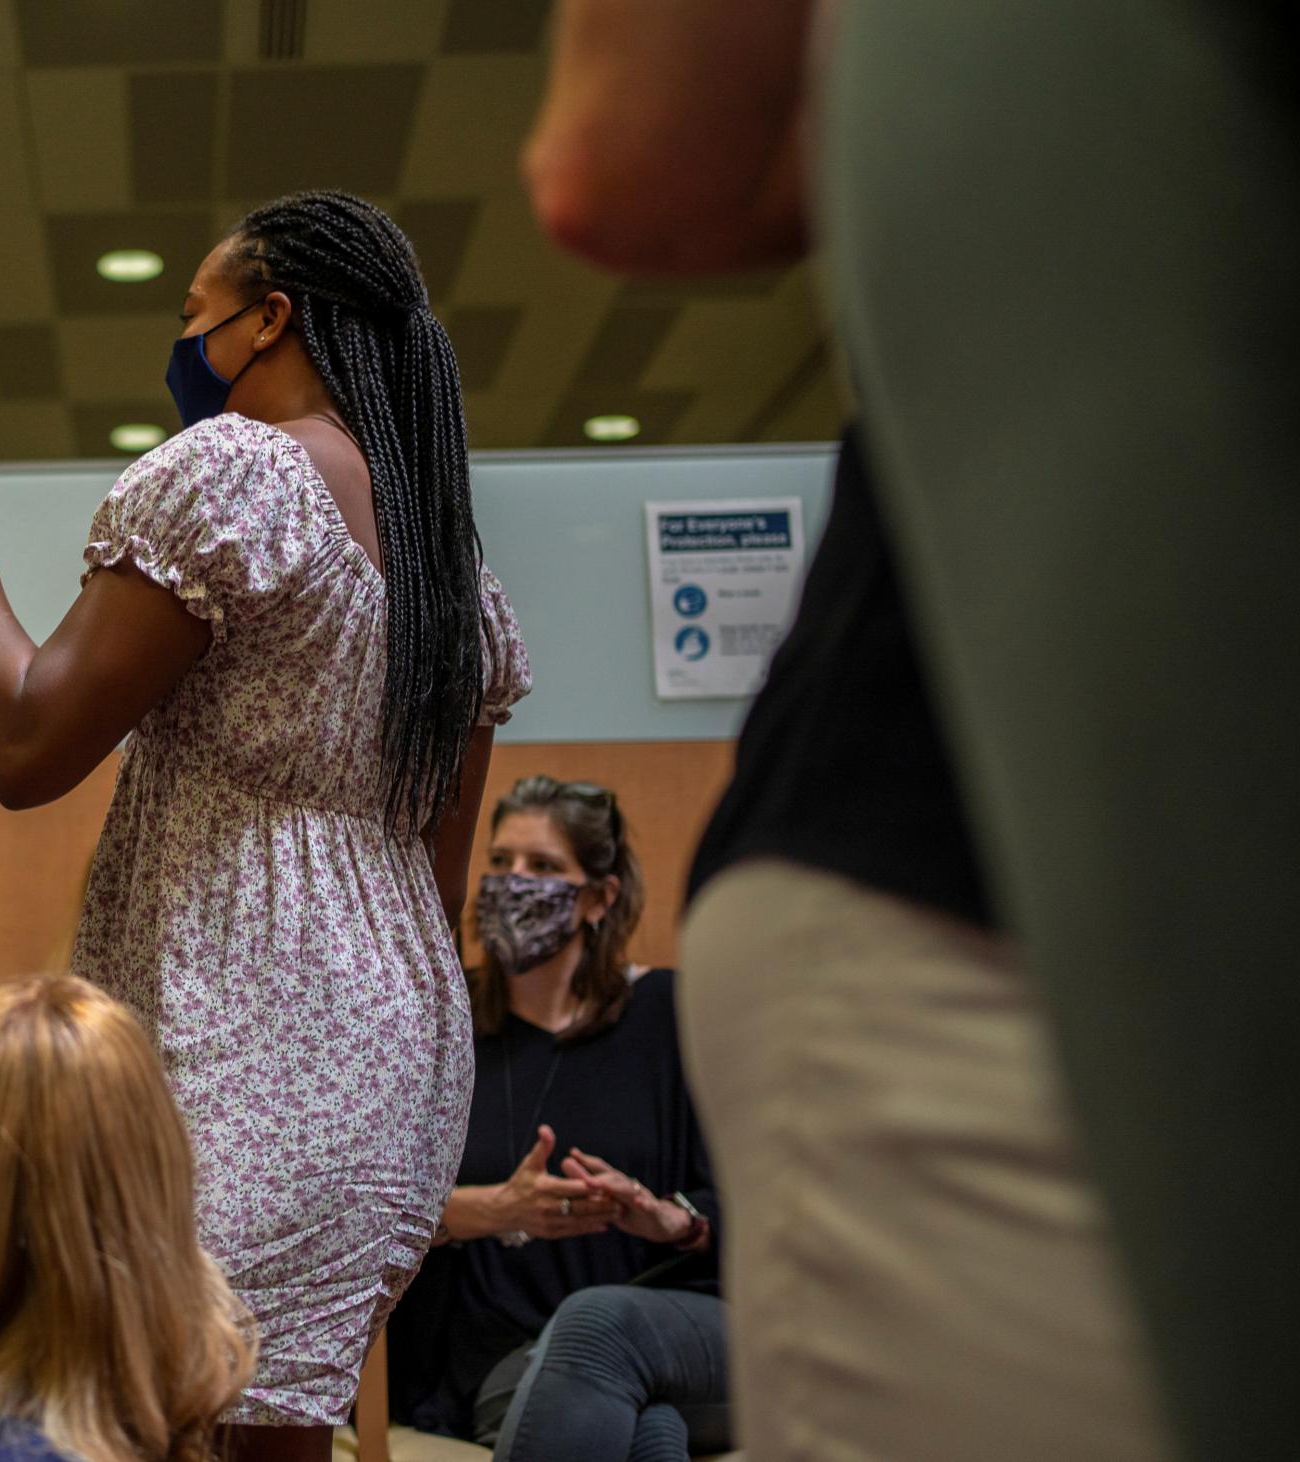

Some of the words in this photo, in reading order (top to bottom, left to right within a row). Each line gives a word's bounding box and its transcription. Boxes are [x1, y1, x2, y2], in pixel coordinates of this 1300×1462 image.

[660, 519, 683, 532] For
[687, 517, 766, 533] Everyone's
[740, 533, 787, 547] please
